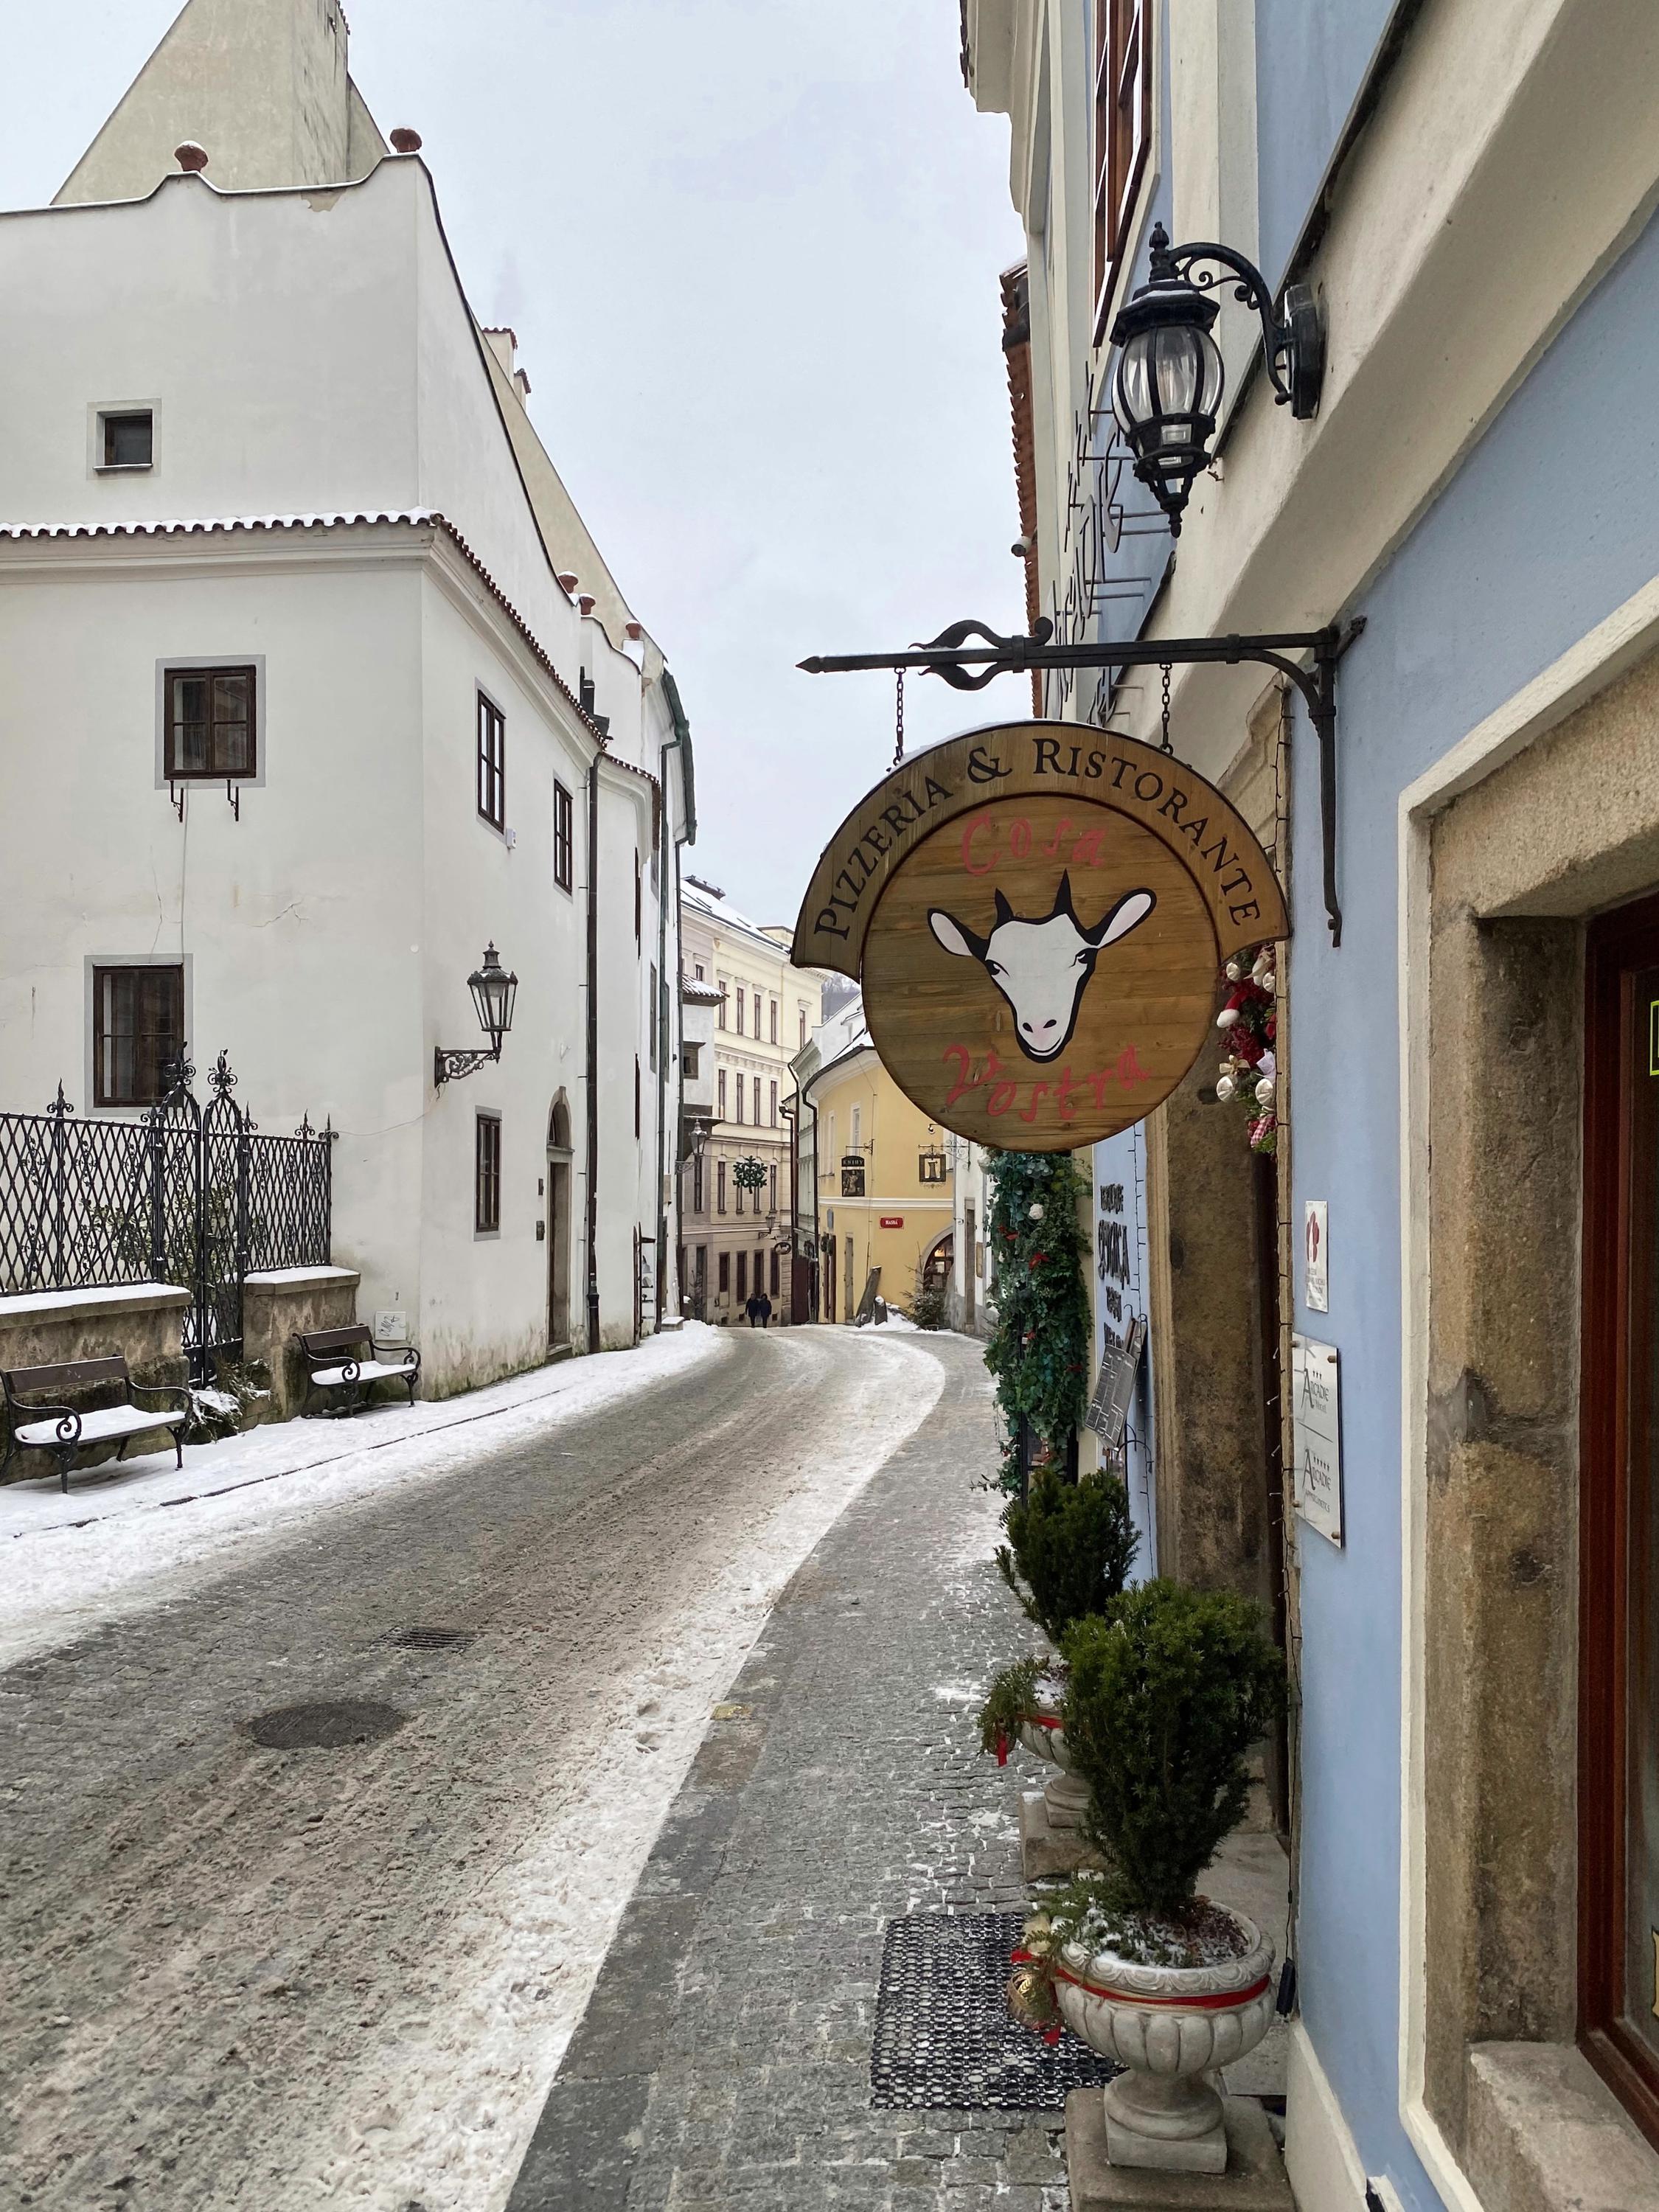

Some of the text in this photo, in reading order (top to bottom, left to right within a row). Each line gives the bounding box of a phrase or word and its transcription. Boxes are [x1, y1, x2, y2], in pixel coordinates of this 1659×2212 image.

[814, 737, 1261, 941] PIZZERIA & RISTORANTE
[960, 813, 1107, 876] Cosa
[943, 1044, 1153, 1123] Vostra
